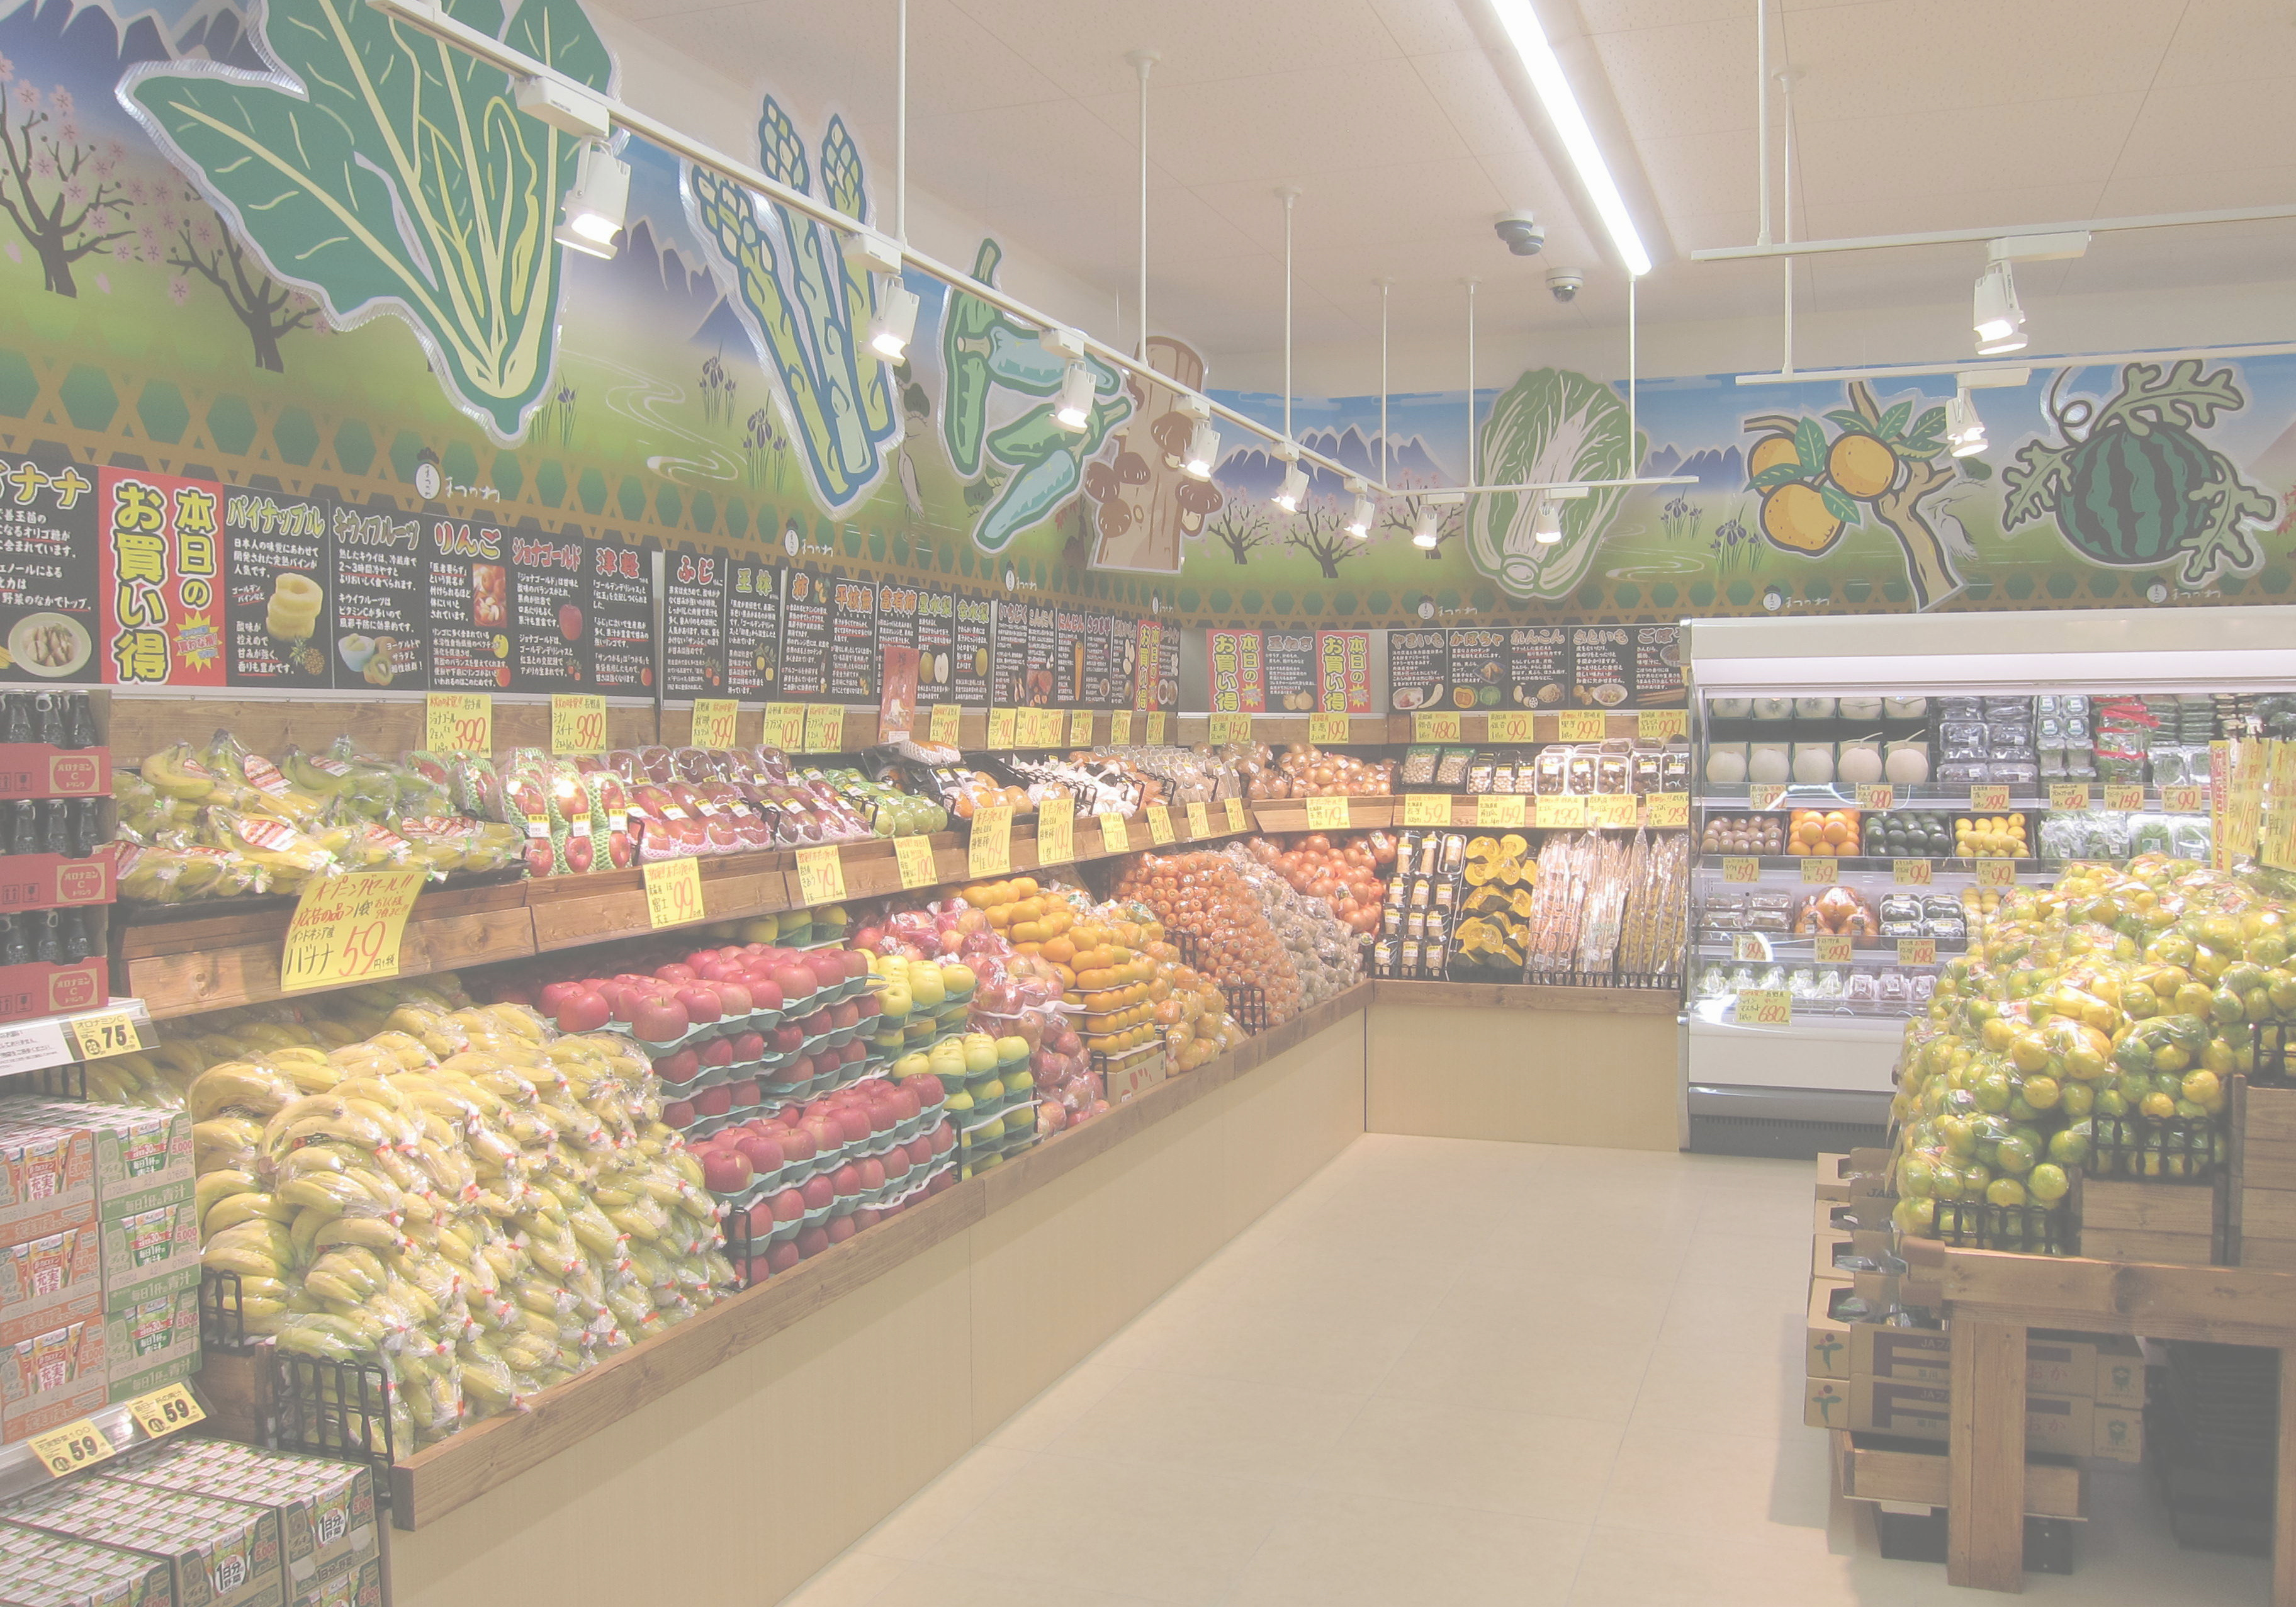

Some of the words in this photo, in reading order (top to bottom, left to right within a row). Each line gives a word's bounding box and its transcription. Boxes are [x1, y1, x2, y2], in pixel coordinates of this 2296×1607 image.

[0, 507, 47, 524] 善玉菌の
[226, 495, 325, 539] パイナップル
[333, 507, 420, 550] キウイフルーツ
[172, 487, 218, 610] 本日の
[234, 538, 319, 558] 日本人の味覚にあわせて
[434, 521, 502, 560] りんご
[233, 550, 317, 569] 開発された完熟パインが
[512, 537, 582, 572] ジョナゴールド
[234, 564, 271, 578] 人気です。
[677, 555, 714, 585] ふじ
[111, 480, 171, 684] お買い得
[232, 584, 261, 595] ゴールデン
[735, 568, 773, 597] 王林
[339, 593, 391, 606] キウイフルーツは
[236, 621, 261, 633] 酸味が
[1057, 612, 1084, 633] にんじん
[237, 634, 269, 646] 控えめで
[1267, 634, 1314, 652] 玉ねぎ
[1392, 633, 1444, 650] やまいも
[1449, 631, 1504, 646] かぼちゃ
[1511, 629, 1565, 645] れんこん
[1573, 629, 1628, 645] さといも
[392, 651, 415, 661] サラダと
[1151, 625, 1161, 679] 本日の
[1239, 633, 1259, 682] 本日の
[1348, 634, 1367, 683] 本日の
[238, 661, 295, 674] 香りも豊かです。
[1136, 624, 1151, 711] お買い得
[1212, 633, 1240, 713] お買い得
[1322, 634, 1348, 713] お買い得
[452, 717, 486, 752] 399
[575, 713, 602, 750] 399
[710, 714, 733, 748] 399
[782, 719, 799, 750] 199
[821, 722, 838, 749] 399
[942, 719, 957, 743] 399
[1229, 721, 1249, 741] 159
[1327, 720, 1346, 741] 199
[1432, 721, 1456, 739] 480
[1507, 719, 1526, 741] 99
[1577, 719, 1600, 738] 299
[57, 764, 93, 772] オロナミン
[70, 772, 79, 781] C
[1871, 790, 1892, 808] 980
[1983, 794, 2005, 809] 299
[2064, 794, 2083, 809] 99
[2119, 791, 2140, 809] 159
[2177, 791, 2195, 809] 99
[1425, 803, 1443, 823] 59
[1500, 804, 1521, 823] 159
[1553, 807, 1579, 825] 139
[1607, 804, 1633, 825] 139
[988, 830, 1003, 869] 69
[1055, 821, 1069, 860] 199
[64, 872, 99, 881] オロナミン
[917, 855, 933, 884] 199
[1736, 863, 1754, 881] 59
[1815, 866, 1833, 882] 59
[1910, 864, 1929, 884] 99
[1991, 866, 2012, 884] 99
[77, 881, 85, 889] C
[816, 863, 835, 898] 79
[674, 877, 694, 920] 99
[339, 921, 386, 976] 59
[1913, 947, 1933, 963] 198
[286, 943, 334, 975] バナナ
[56, 979, 92, 988] オロナミン
[76, 1015, 125, 1029] オロナミンC
[1758, 1005, 1786, 1022] 680
[102, 1025, 127, 1048] 75
[32, 1174, 53, 1192] 充実
[37, 1268, 59, 1285] 充実
[42, 1363, 64, 1382] 充実
[163, 1399, 189, 1423] 59
[68, 1436, 98, 1461] 59
